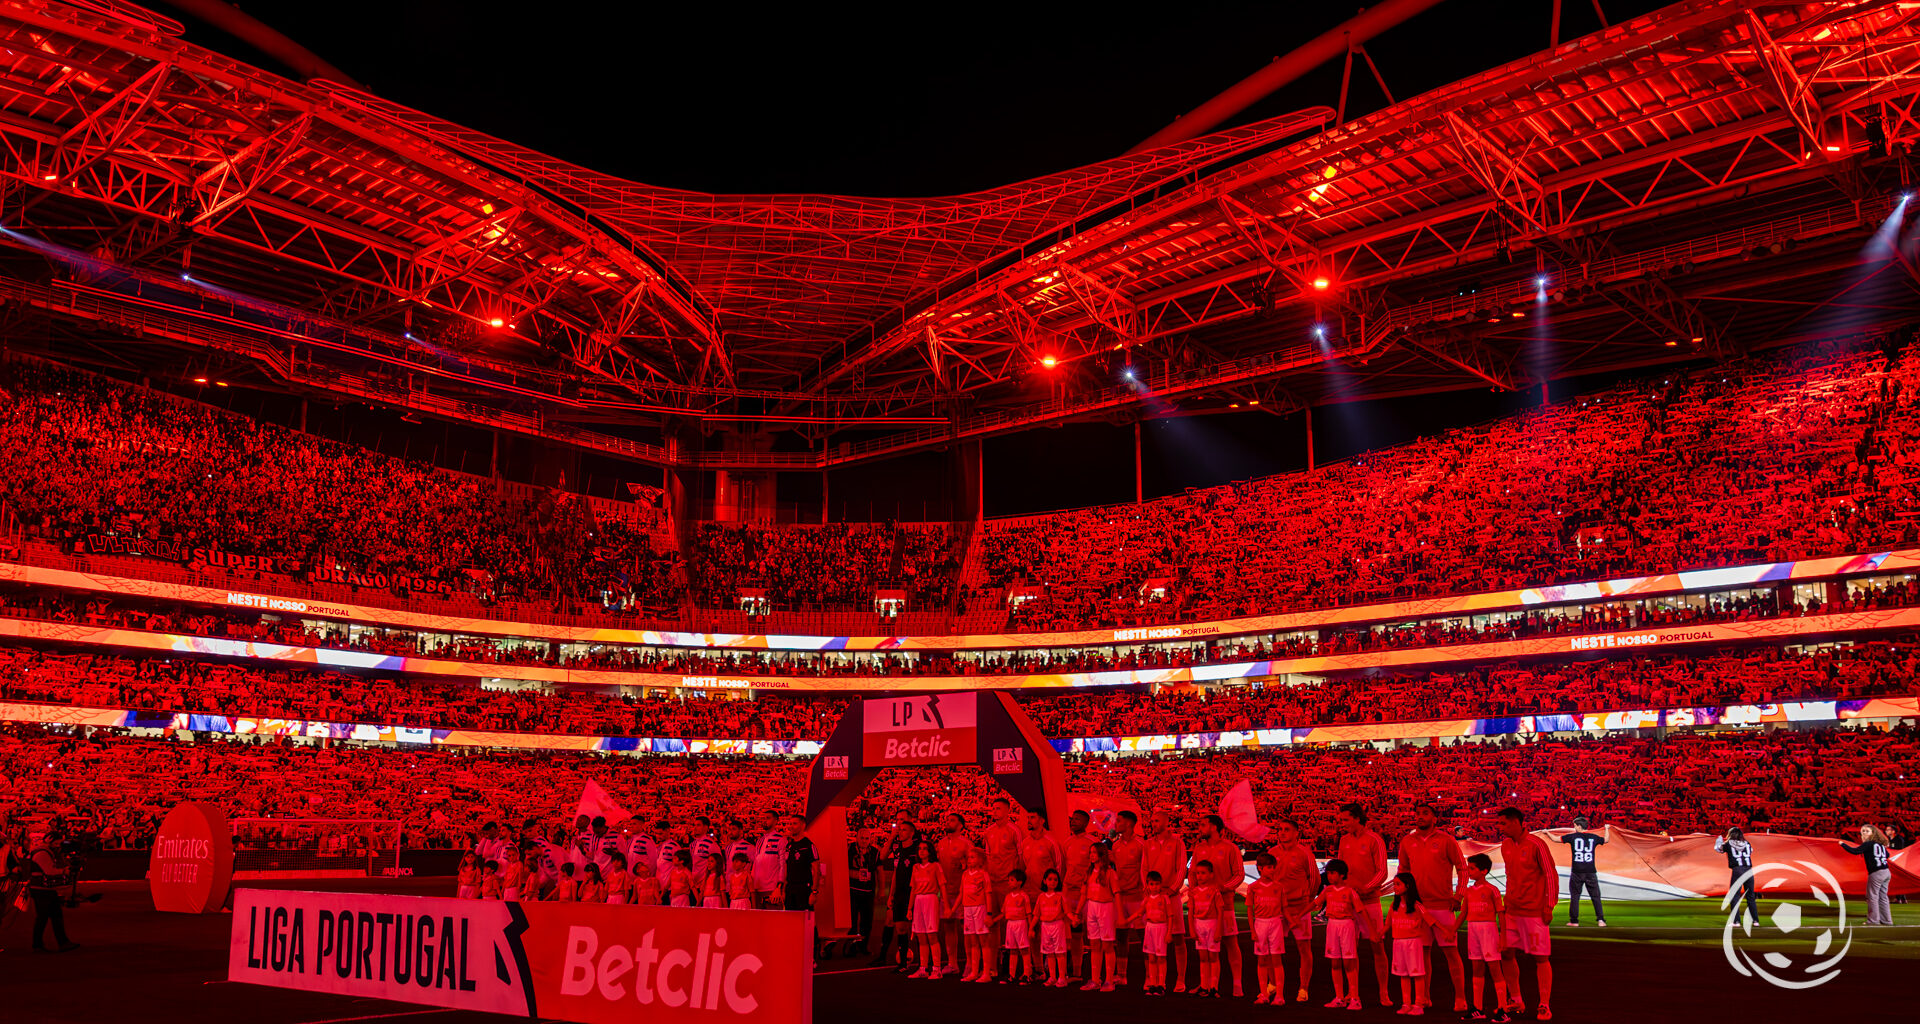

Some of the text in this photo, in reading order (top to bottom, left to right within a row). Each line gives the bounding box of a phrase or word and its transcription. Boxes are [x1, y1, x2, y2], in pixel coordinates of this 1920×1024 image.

[193, 548, 273, 572] SUPER
[227, 593, 350, 616] NESTE NOSSO PORTUGAL
[1113, 626, 1220, 640] NESTE NOSSO PORTUGAL
[1570, 631, 1714, 650] NESTE NOSSO PORTUGAL
[682, 677, 717, 687] NESTE
[884, 735, 951, 759] Betclic
[995, 763, 1020, 771] Betclic
[157, 833, 208, 859] Emirates
[1574, 838, 1594, 852] OJ
[248, 906, 476, 992] LIGA PORTUGAL
[560, 924, 763, 1015] Betclic
